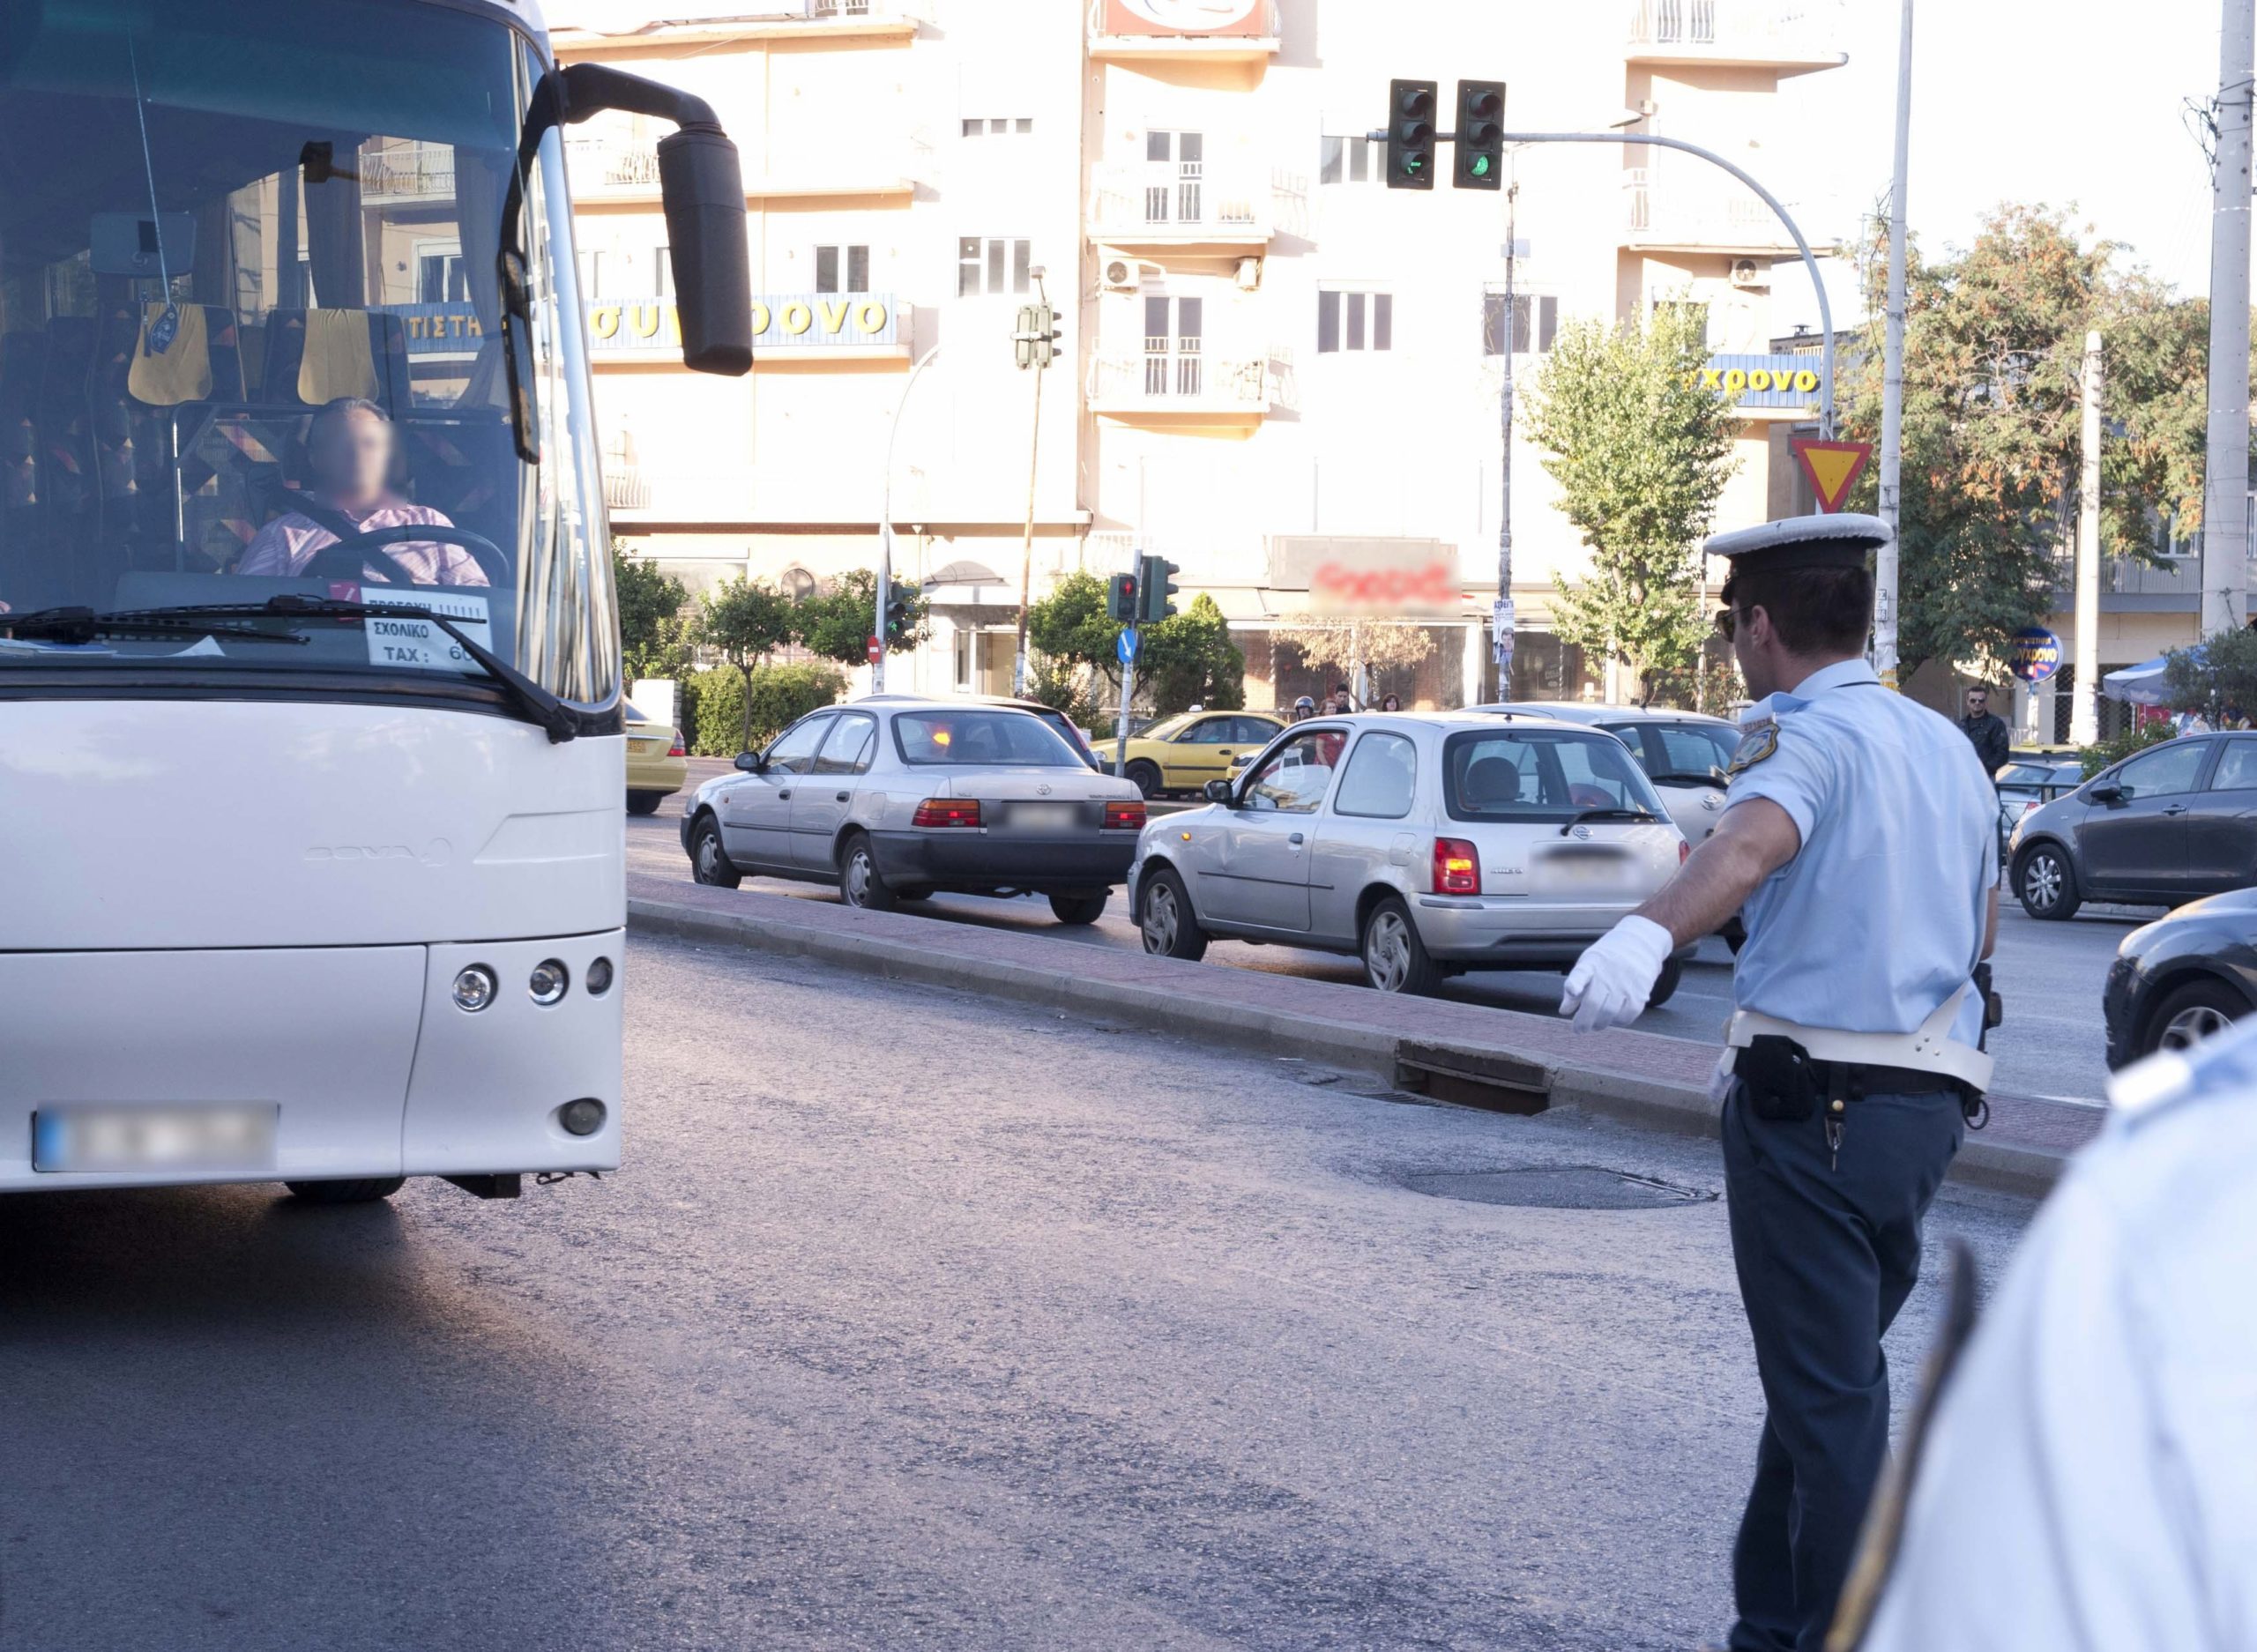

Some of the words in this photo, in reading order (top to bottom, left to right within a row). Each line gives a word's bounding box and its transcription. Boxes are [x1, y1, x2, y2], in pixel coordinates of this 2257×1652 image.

[408, 315, 483, 339] ΤΙΣΤΗ
[1684, 368, 1819, 398] χρονο
[373, 621, 429, 639] ΣΧΟΛΙΚΟ
